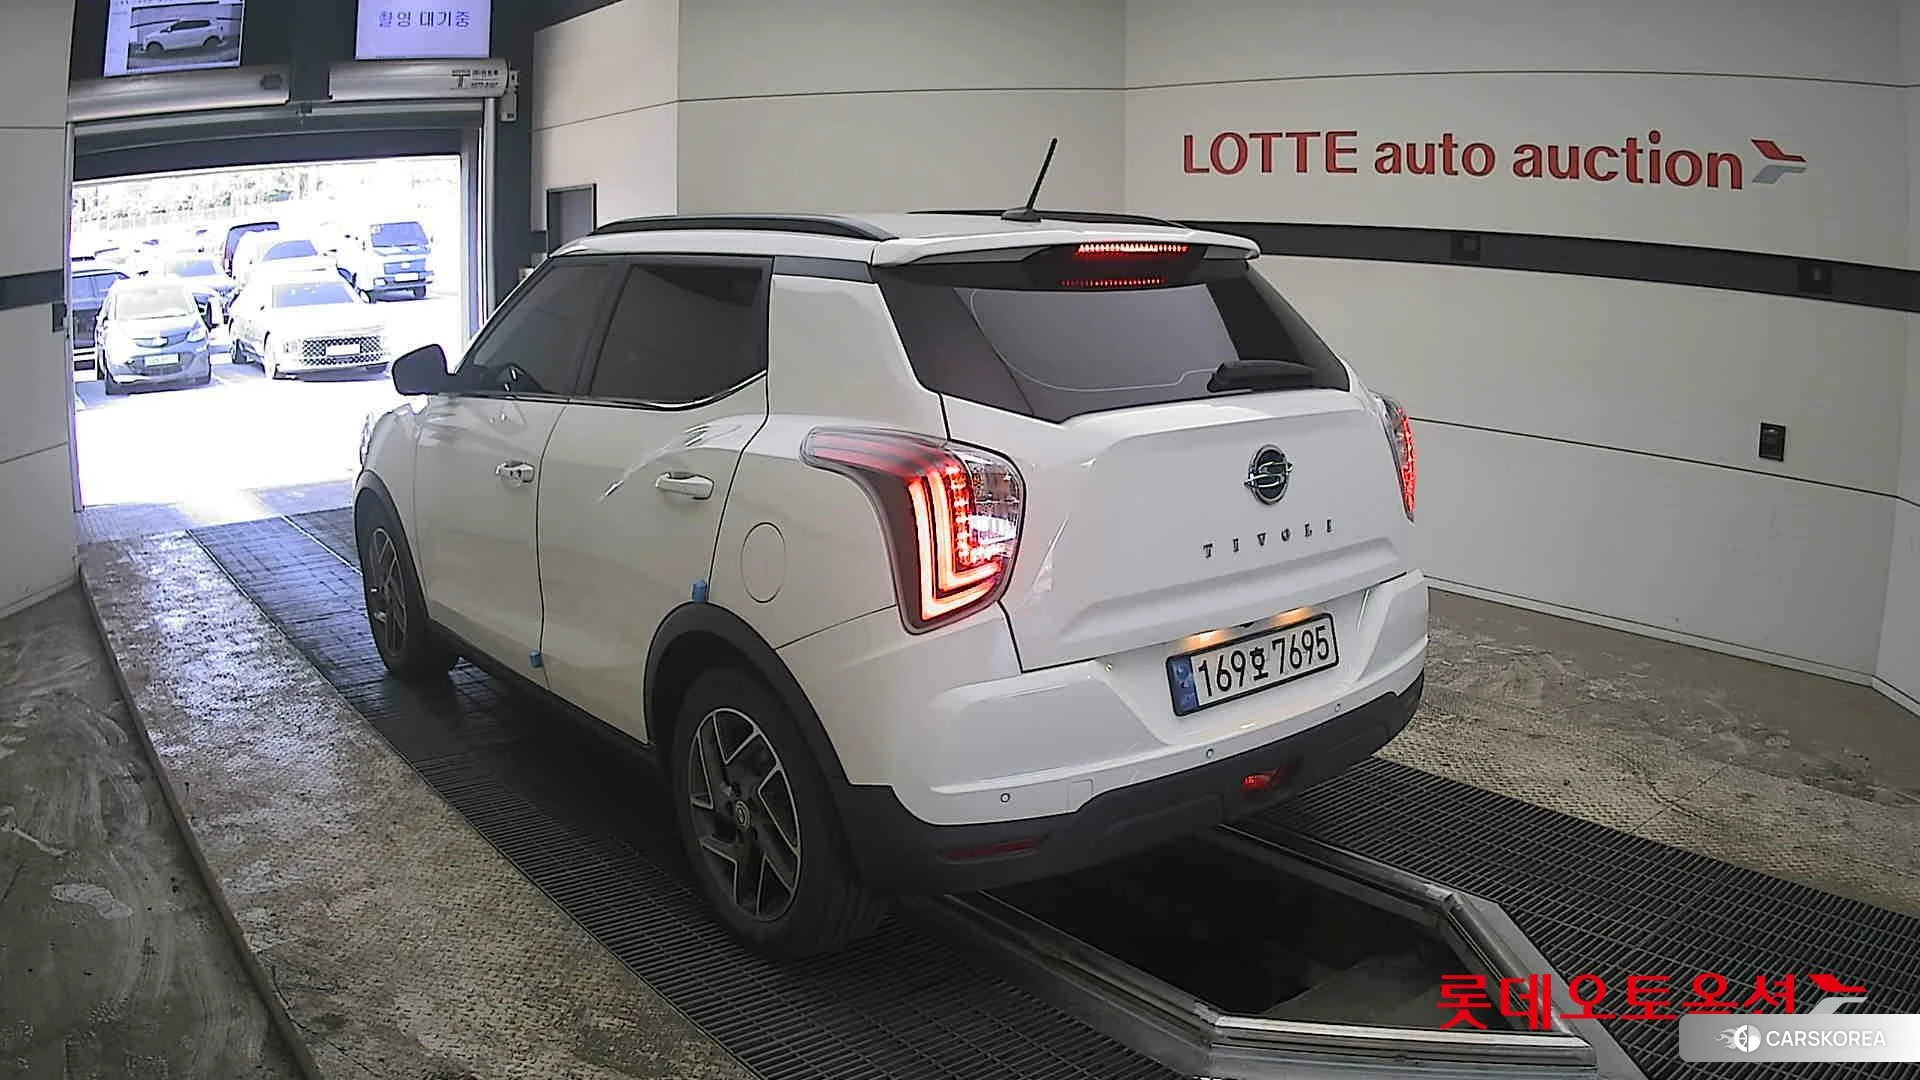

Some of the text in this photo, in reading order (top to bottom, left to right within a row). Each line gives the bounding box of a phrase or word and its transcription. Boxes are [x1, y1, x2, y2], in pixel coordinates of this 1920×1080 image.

[419, 11, 470, 28] 대기중
[1183, 129, 1743, 190] LOTTE auto auction
[1202, 519, 1333, 559] TIVOLI
